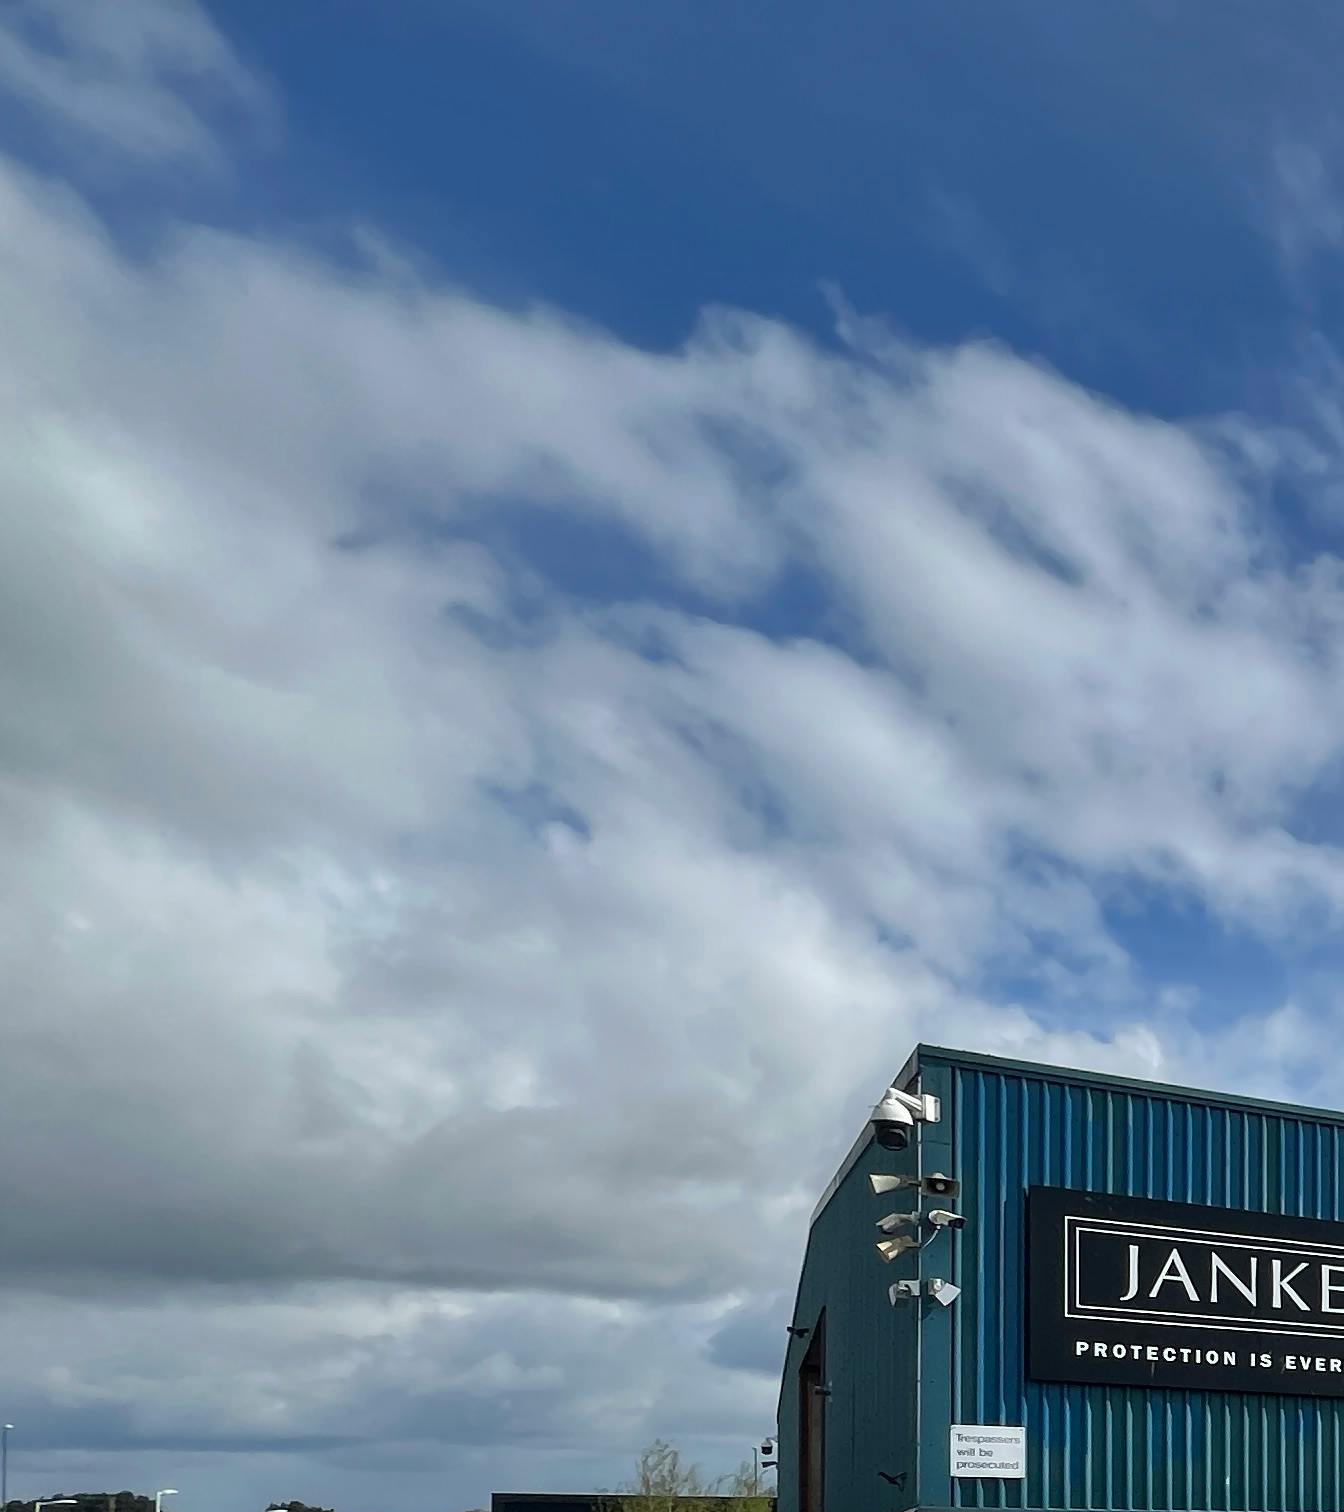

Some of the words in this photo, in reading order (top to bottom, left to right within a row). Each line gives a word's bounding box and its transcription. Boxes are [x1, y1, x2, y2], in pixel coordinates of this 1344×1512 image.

[1075, 1341, 1237, 1366] PROTECTION
[1250, 1352, 1272, 1368] IS
[955, 1433, 1021, 1444] Trespassers
[956, 1447, 976, 1457] will
[979, 1447, 994, 1457] be
[956, 1461, 1019, 1470] prosecuted
